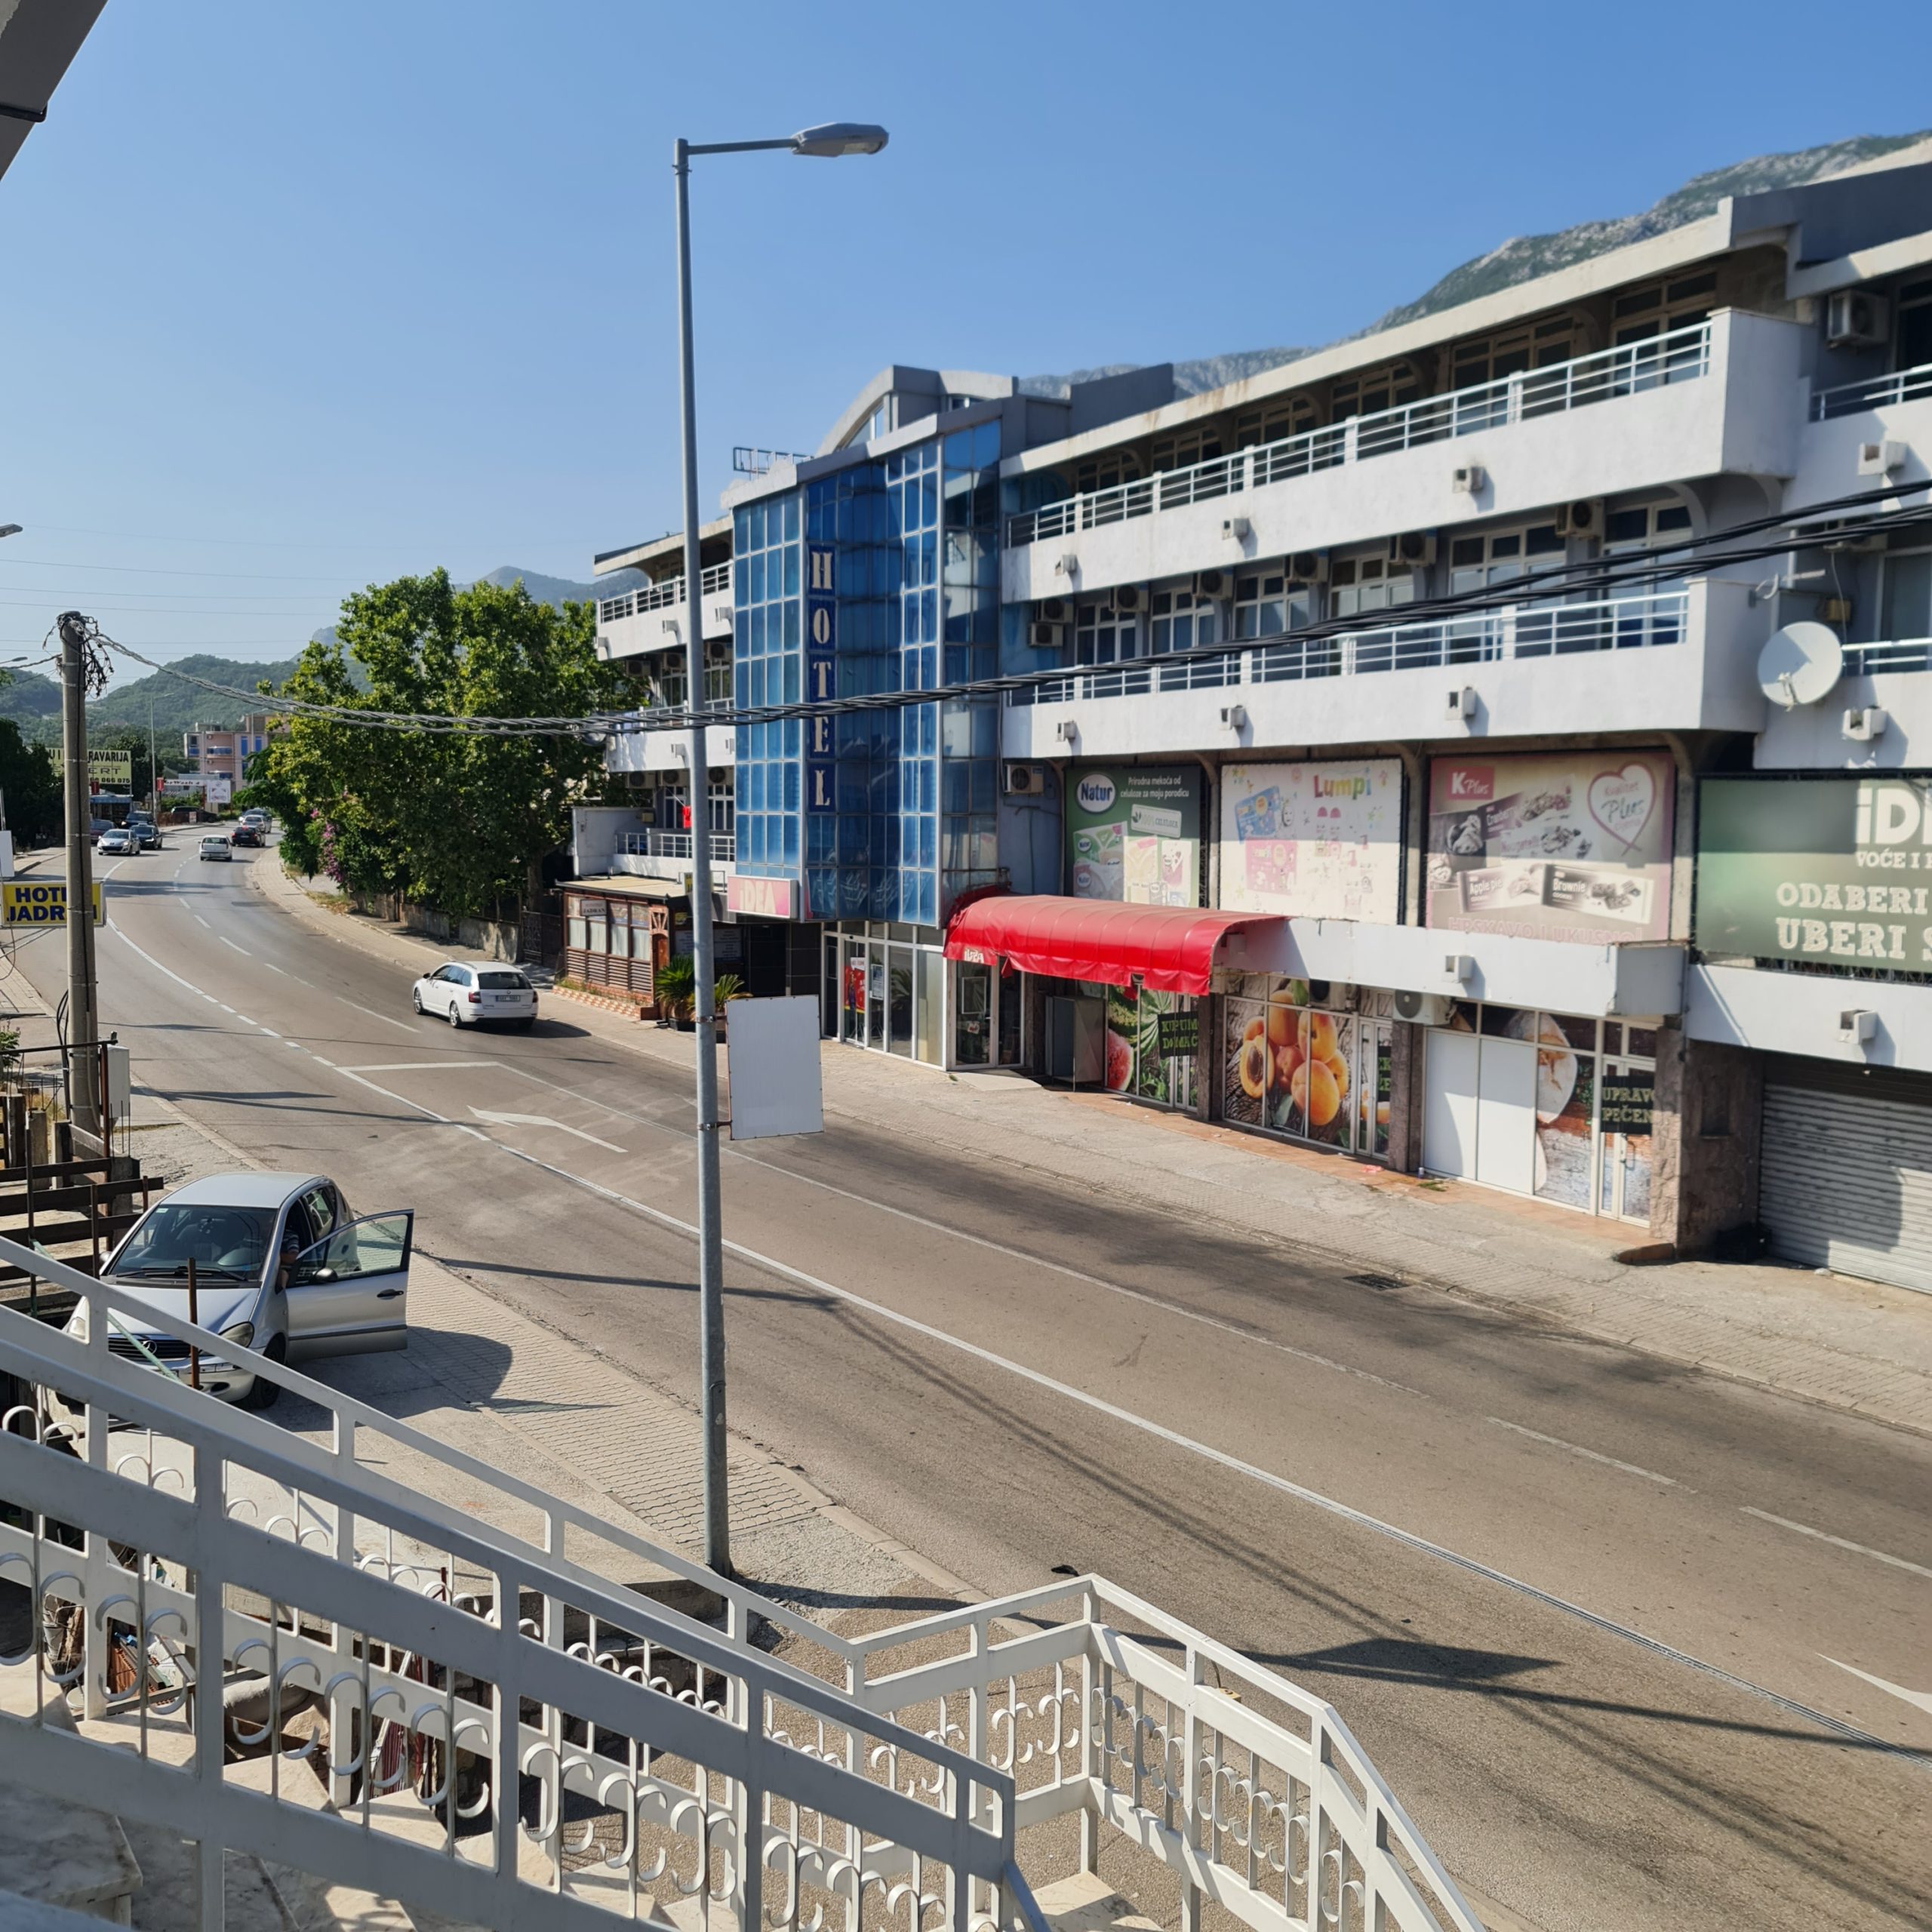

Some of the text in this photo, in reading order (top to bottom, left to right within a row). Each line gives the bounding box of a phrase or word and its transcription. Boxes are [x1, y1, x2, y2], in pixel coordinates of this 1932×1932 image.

[811, 552, 833, 806] HOTEL
[88, 750, 129, 763] RAVARIJA
[1128, 777, 1151, 786] Prirodna
[1173, 776, 1182, 785] od
[1313, 768, 1371, 800] Lumpi
[1451, 772, 1490, 795] K Plus
[1081, 783, 1112, 801] Natur
[1120, 789, 1142, 798] celuloze
[1149, 789, 1164, 800] moju
[1600, 797, 1645, 823] Plus
[1855, 787, 1932, 845] iD
[1856, 848, 1906, 868] VOĆE
[15, 887, 66, 903] HOT
[1469, 878, 1503, 895] Apple pie
[1552, 878, 1586, 894] Brownie
[1777, 882, 1929, 915] ODABERI
[7, 905, 97, 921] JADR
[1776, 917, 1907, 960] UBERI
